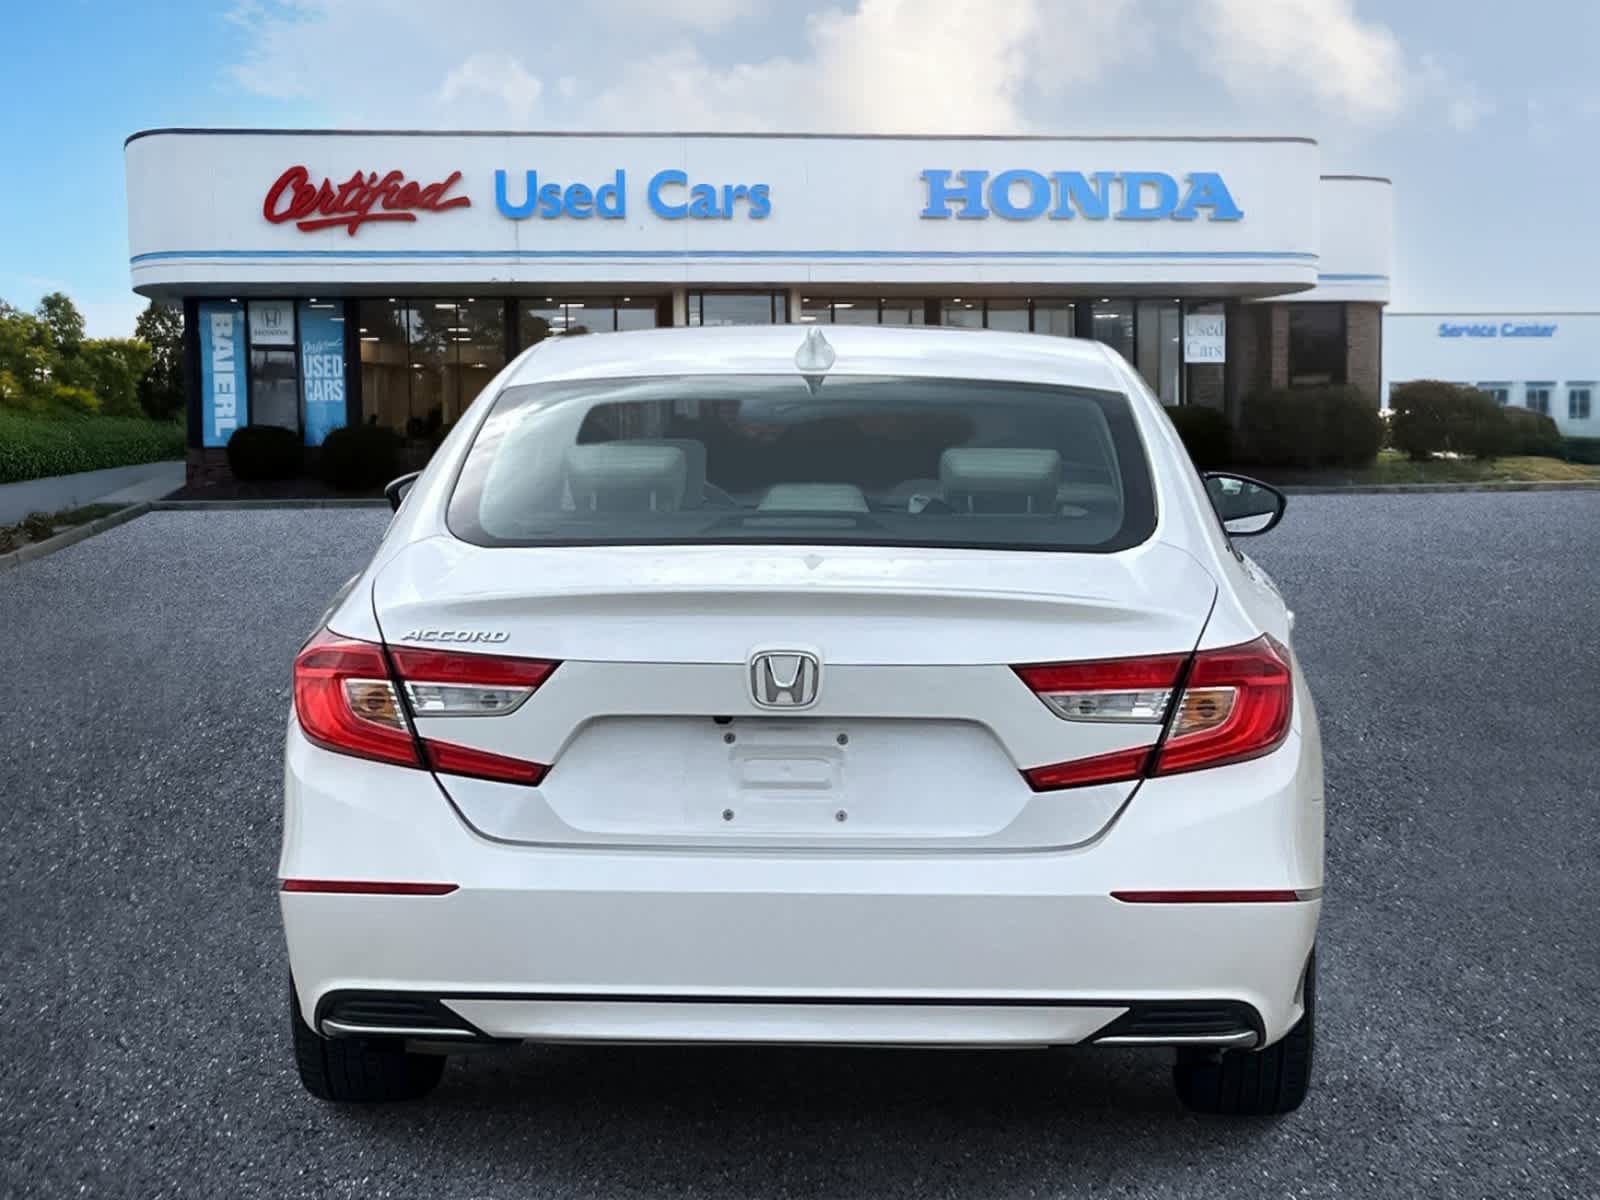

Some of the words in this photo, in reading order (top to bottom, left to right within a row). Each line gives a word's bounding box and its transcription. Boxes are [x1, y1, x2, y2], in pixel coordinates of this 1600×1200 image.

[264, 166, 470, 235] Certified
[495, 169, 626, 219] Used
[648, 169, 771, 219] Cars
[919, 169, 1244, 221] HONDA
[1186, 319, 1225, 336] Used
[1439, 323, 1497, 337] Service
[1501, 323, 1557, 337] Center
[1186, 342, 1223, 357] Cars
[211, 313, 237, 437] BAIERL
[303, 354, 343, 377] USED
[304, 379, 343, 401] CARS
[401, 628, 510, 644] ACCORD
